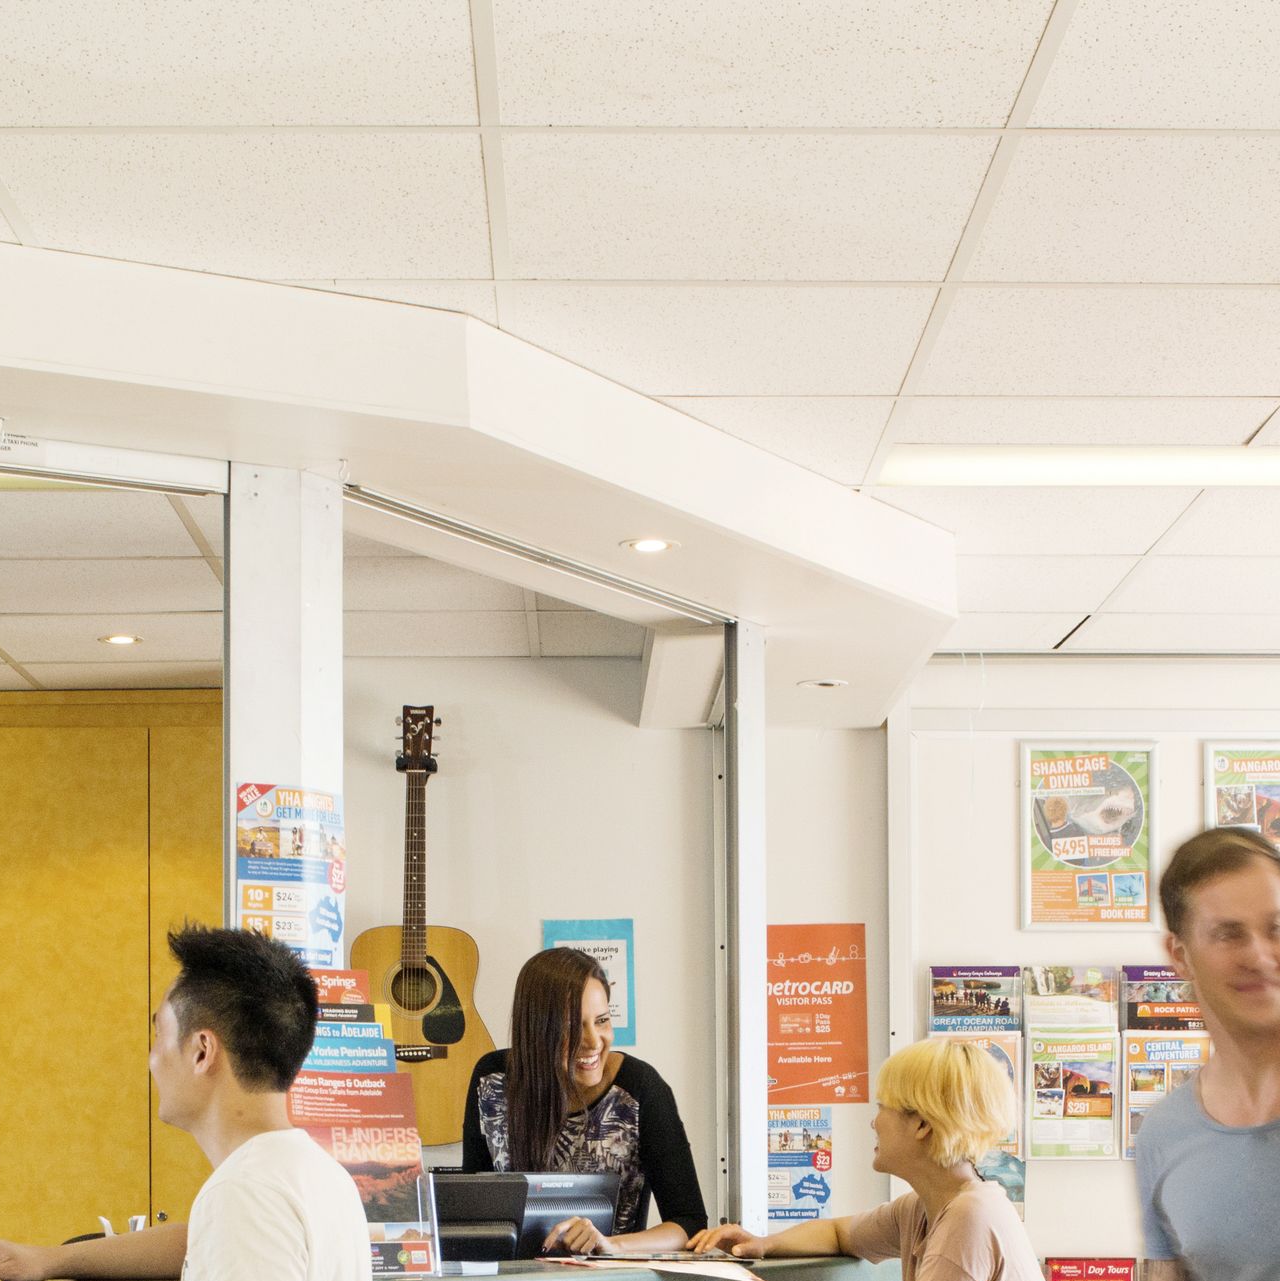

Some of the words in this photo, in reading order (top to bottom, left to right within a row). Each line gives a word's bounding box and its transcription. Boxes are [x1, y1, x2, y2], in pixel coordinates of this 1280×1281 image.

[1032, 759, 1074, 776] SHARK
[1075, 756, 1108, 772] CAGE
[1048, 773, 1091, 789] DIVING
[277, 790, 302, 807] YHA
[276, 806, 292, 818] GET
[1053, 838, 1087, 858] $495
[1100, 908, 1124, 919] BOOK
[1123, 908, 1146, 919] HERE
[592, 946, 620, 954] playing
[321, 975, 357, 990] Springs
[776, 997, 811, 1006] VISITOR
[811, 997, 833, 1005] PASS
[933, 1017, 962, 1026] GREAT
[963, 1017, 994, 1025] OCEAN
[995, 1017, 1020, 1025] ROAD
[332, 1027, 340, 1037] to
[341, 1024, 380, 1038] ADELAIDE
[312, 1045, 339, 1057] Yorke
[340, 1046, 388, 1057] Peninsula
[1047, 1044, 1086, 1054] KANGAROO
[1086, 1042, 1113, 1052] ISLAND
[1145, 1040, 1181, 1052] CENTRAL
[777, 1056, 813, 1064] Available
[1149, 1050, 1200, 1061] ADVENTURES
[318, 1077, 346, 1089] Ranges
[346, 1079, 353, 1088] &
[353, 1079, 387, 1089] Outback
[1067, 1101, 1090, 1113] $291
[768, 1109, 786, 1119] YHA
[786, 1109, 821, 1120] eNIGHTS
[767, 1119, 780, 1128] GET
[780, 1119, 799, 1128] MORE
[799, 1119, 812, 1128] FOR
[812, 1119, 829, 1128] LESS
[331, 1126, 419, 1144] FLINDERS
[332, 1143, 421, 1161] RANGES
[816, 1155, 831, 1166] $23
[1087, 1265, 1106, 1276] Day
[1107, 1265, 1130, 1275] Tours
